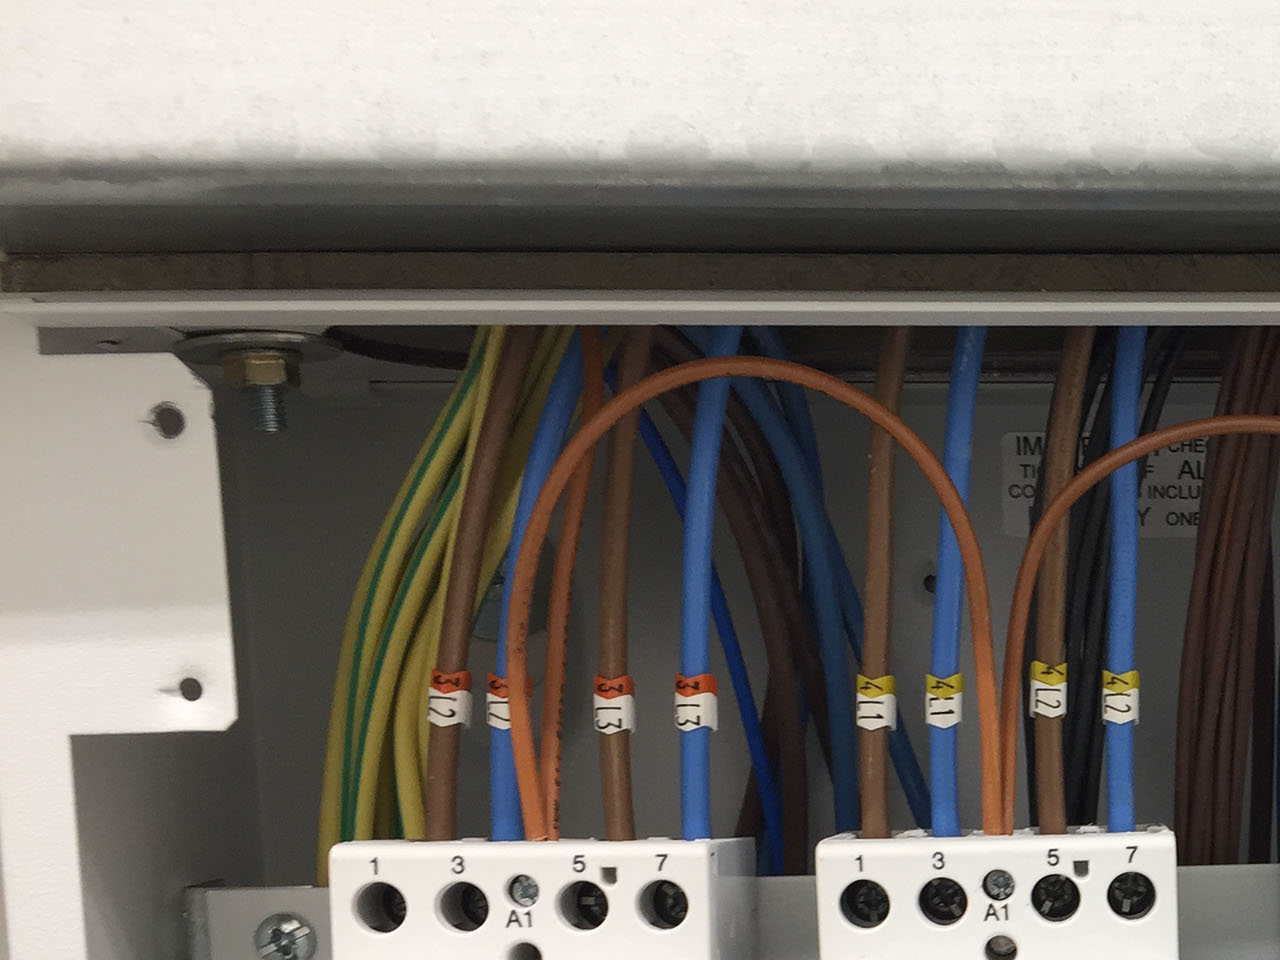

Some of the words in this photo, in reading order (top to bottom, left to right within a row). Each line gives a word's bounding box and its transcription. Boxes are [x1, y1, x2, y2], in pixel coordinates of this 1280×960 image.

[1148, 485, 1201, 499] INCLU
[370, 857, 378, 875] 1
[452, 856, 465, 874] 3
[573, 855, 586, 873] 5
[656, 854, 668, 871] 7
[856, 855, 863, 872] 1
[933, 852, 945, 870] 3
[1048, 849, 1059, 866] 5
[1126, 846, 1137, 863] 7
[506, 910, 532, 928] A1
[984, 903, 1008, 921] A1
